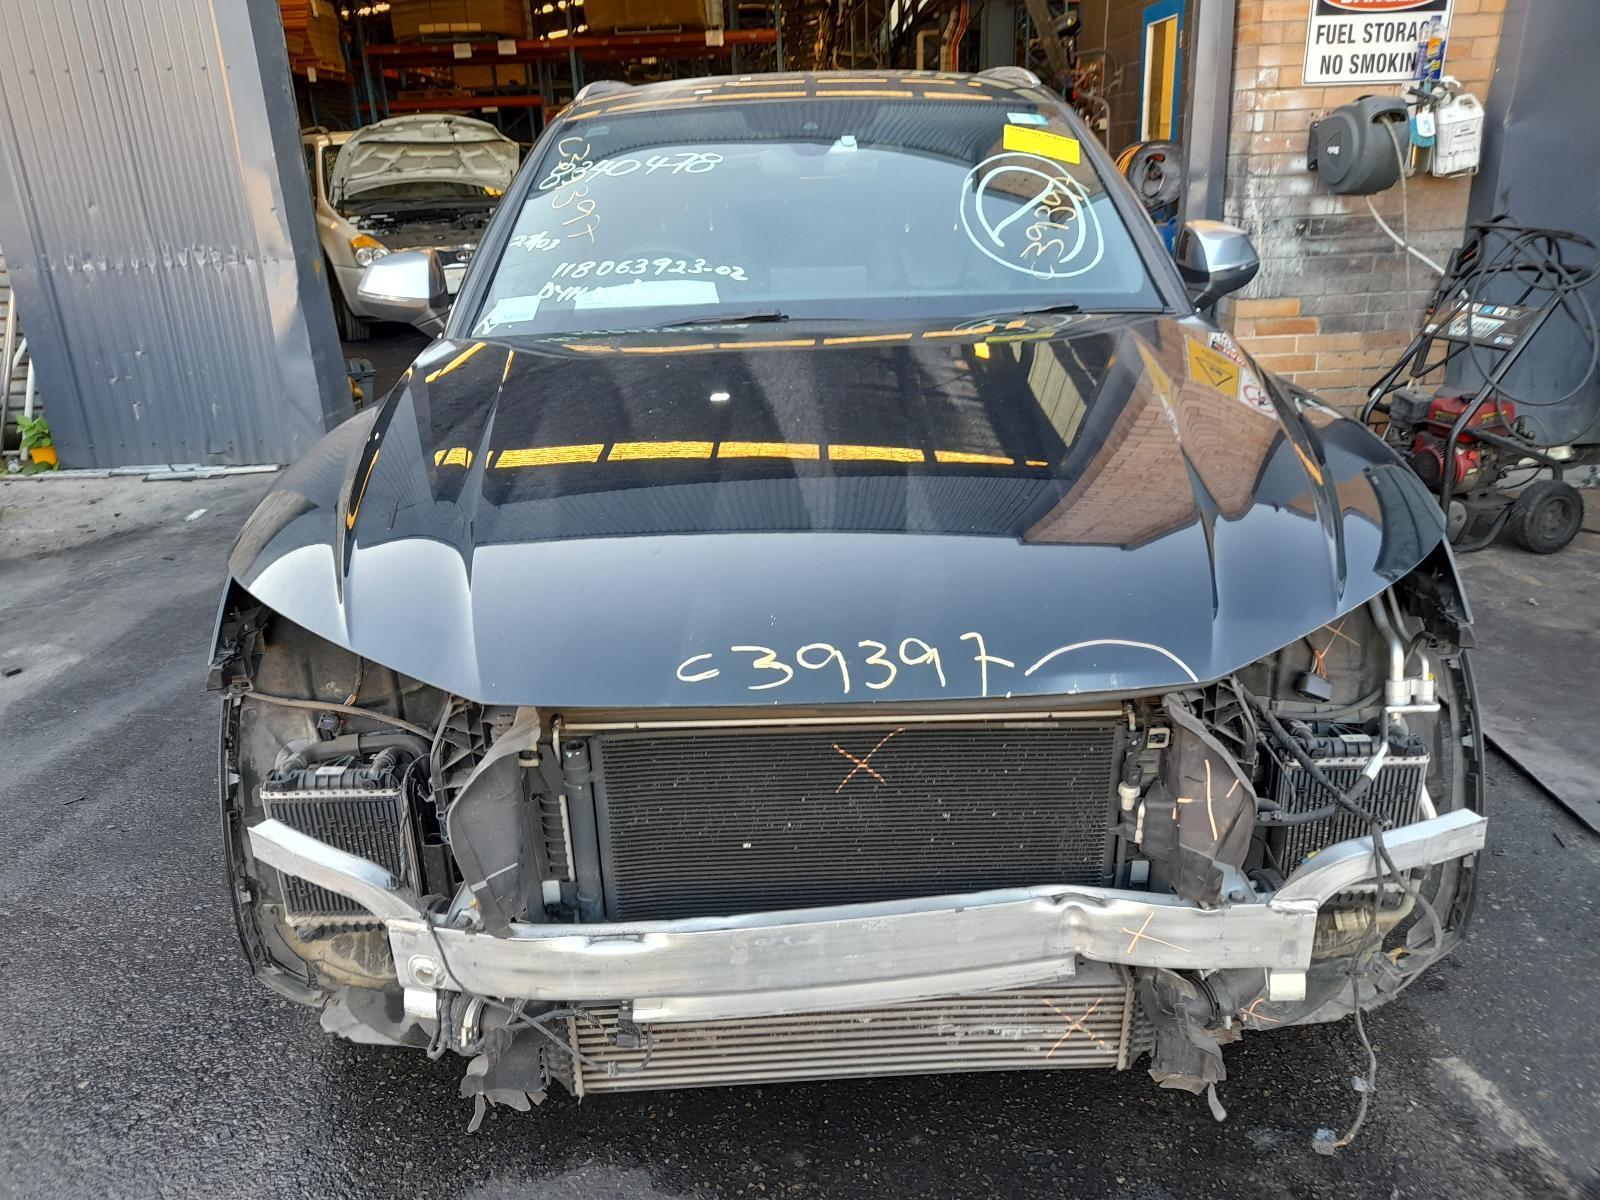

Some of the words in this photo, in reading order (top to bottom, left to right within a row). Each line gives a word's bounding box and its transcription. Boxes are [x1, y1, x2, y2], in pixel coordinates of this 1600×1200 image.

[1315, 23, 1356, 45] FUEL
[1319, 54, 1343, 75] NO
[1349, 51, 1417, 75] SMOKIN
